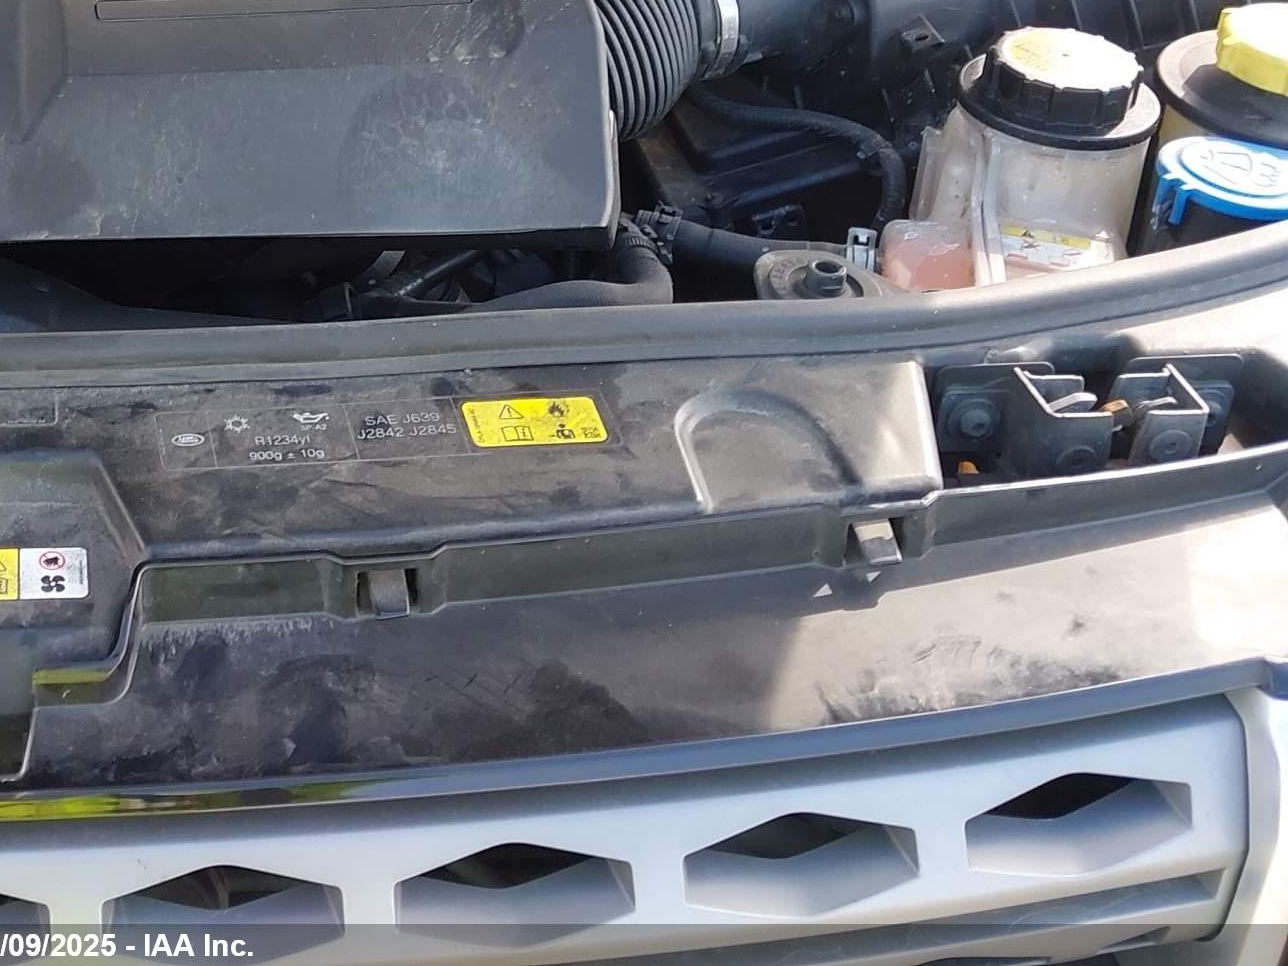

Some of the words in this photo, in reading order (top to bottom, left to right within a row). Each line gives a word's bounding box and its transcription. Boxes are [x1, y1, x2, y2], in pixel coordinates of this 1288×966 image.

[365, 414, 398, 426] SAE
[403, 412, 440, 424] J639
[358, 426, 404, 439] J2842
[410, 424, 456, 436] J2845
[254, 434, 311, 446] R1234yf
[249, 450, 283, 462] 900g
[300, 448, 325, 460] 10g
